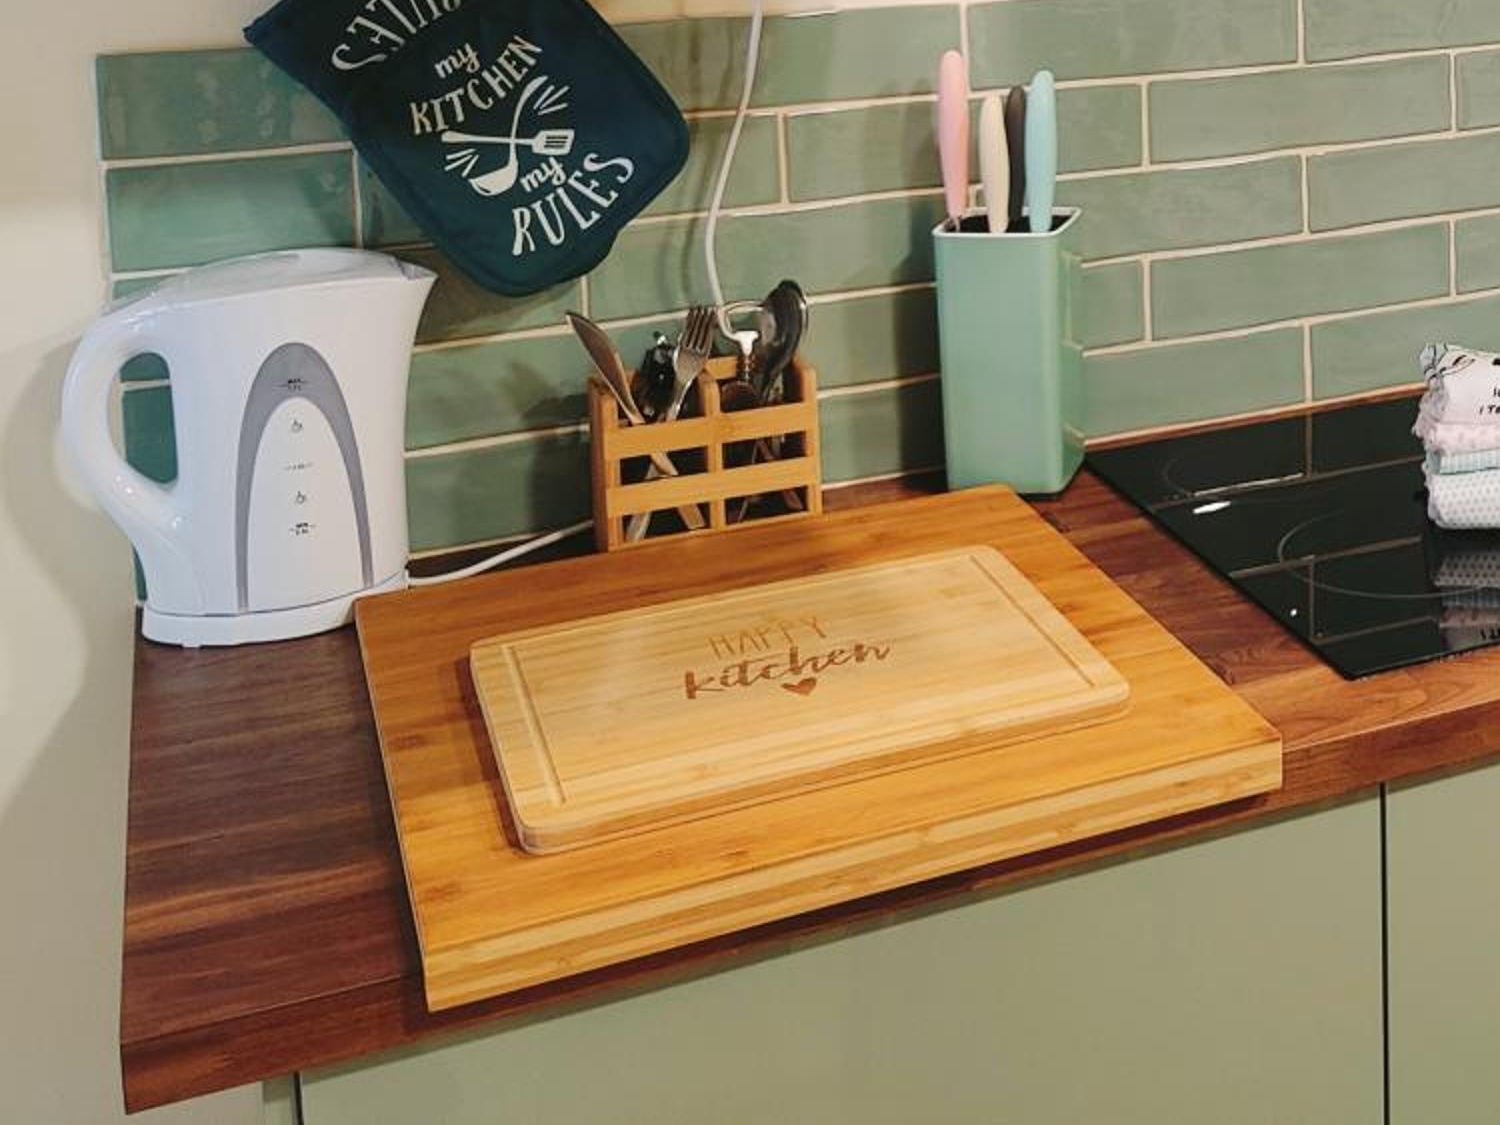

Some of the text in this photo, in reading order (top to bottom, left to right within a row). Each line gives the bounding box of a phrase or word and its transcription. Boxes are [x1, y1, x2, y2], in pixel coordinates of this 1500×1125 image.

[409, 35, 544, 136] KITCHEN
[434, 43, 482, 79] my
[520, 157, 569, 193] my
[512, 153, 634, 257] RULES
[707, 617, 827, 659] HAPPY
[684, 644, 890, 700] kitchen
